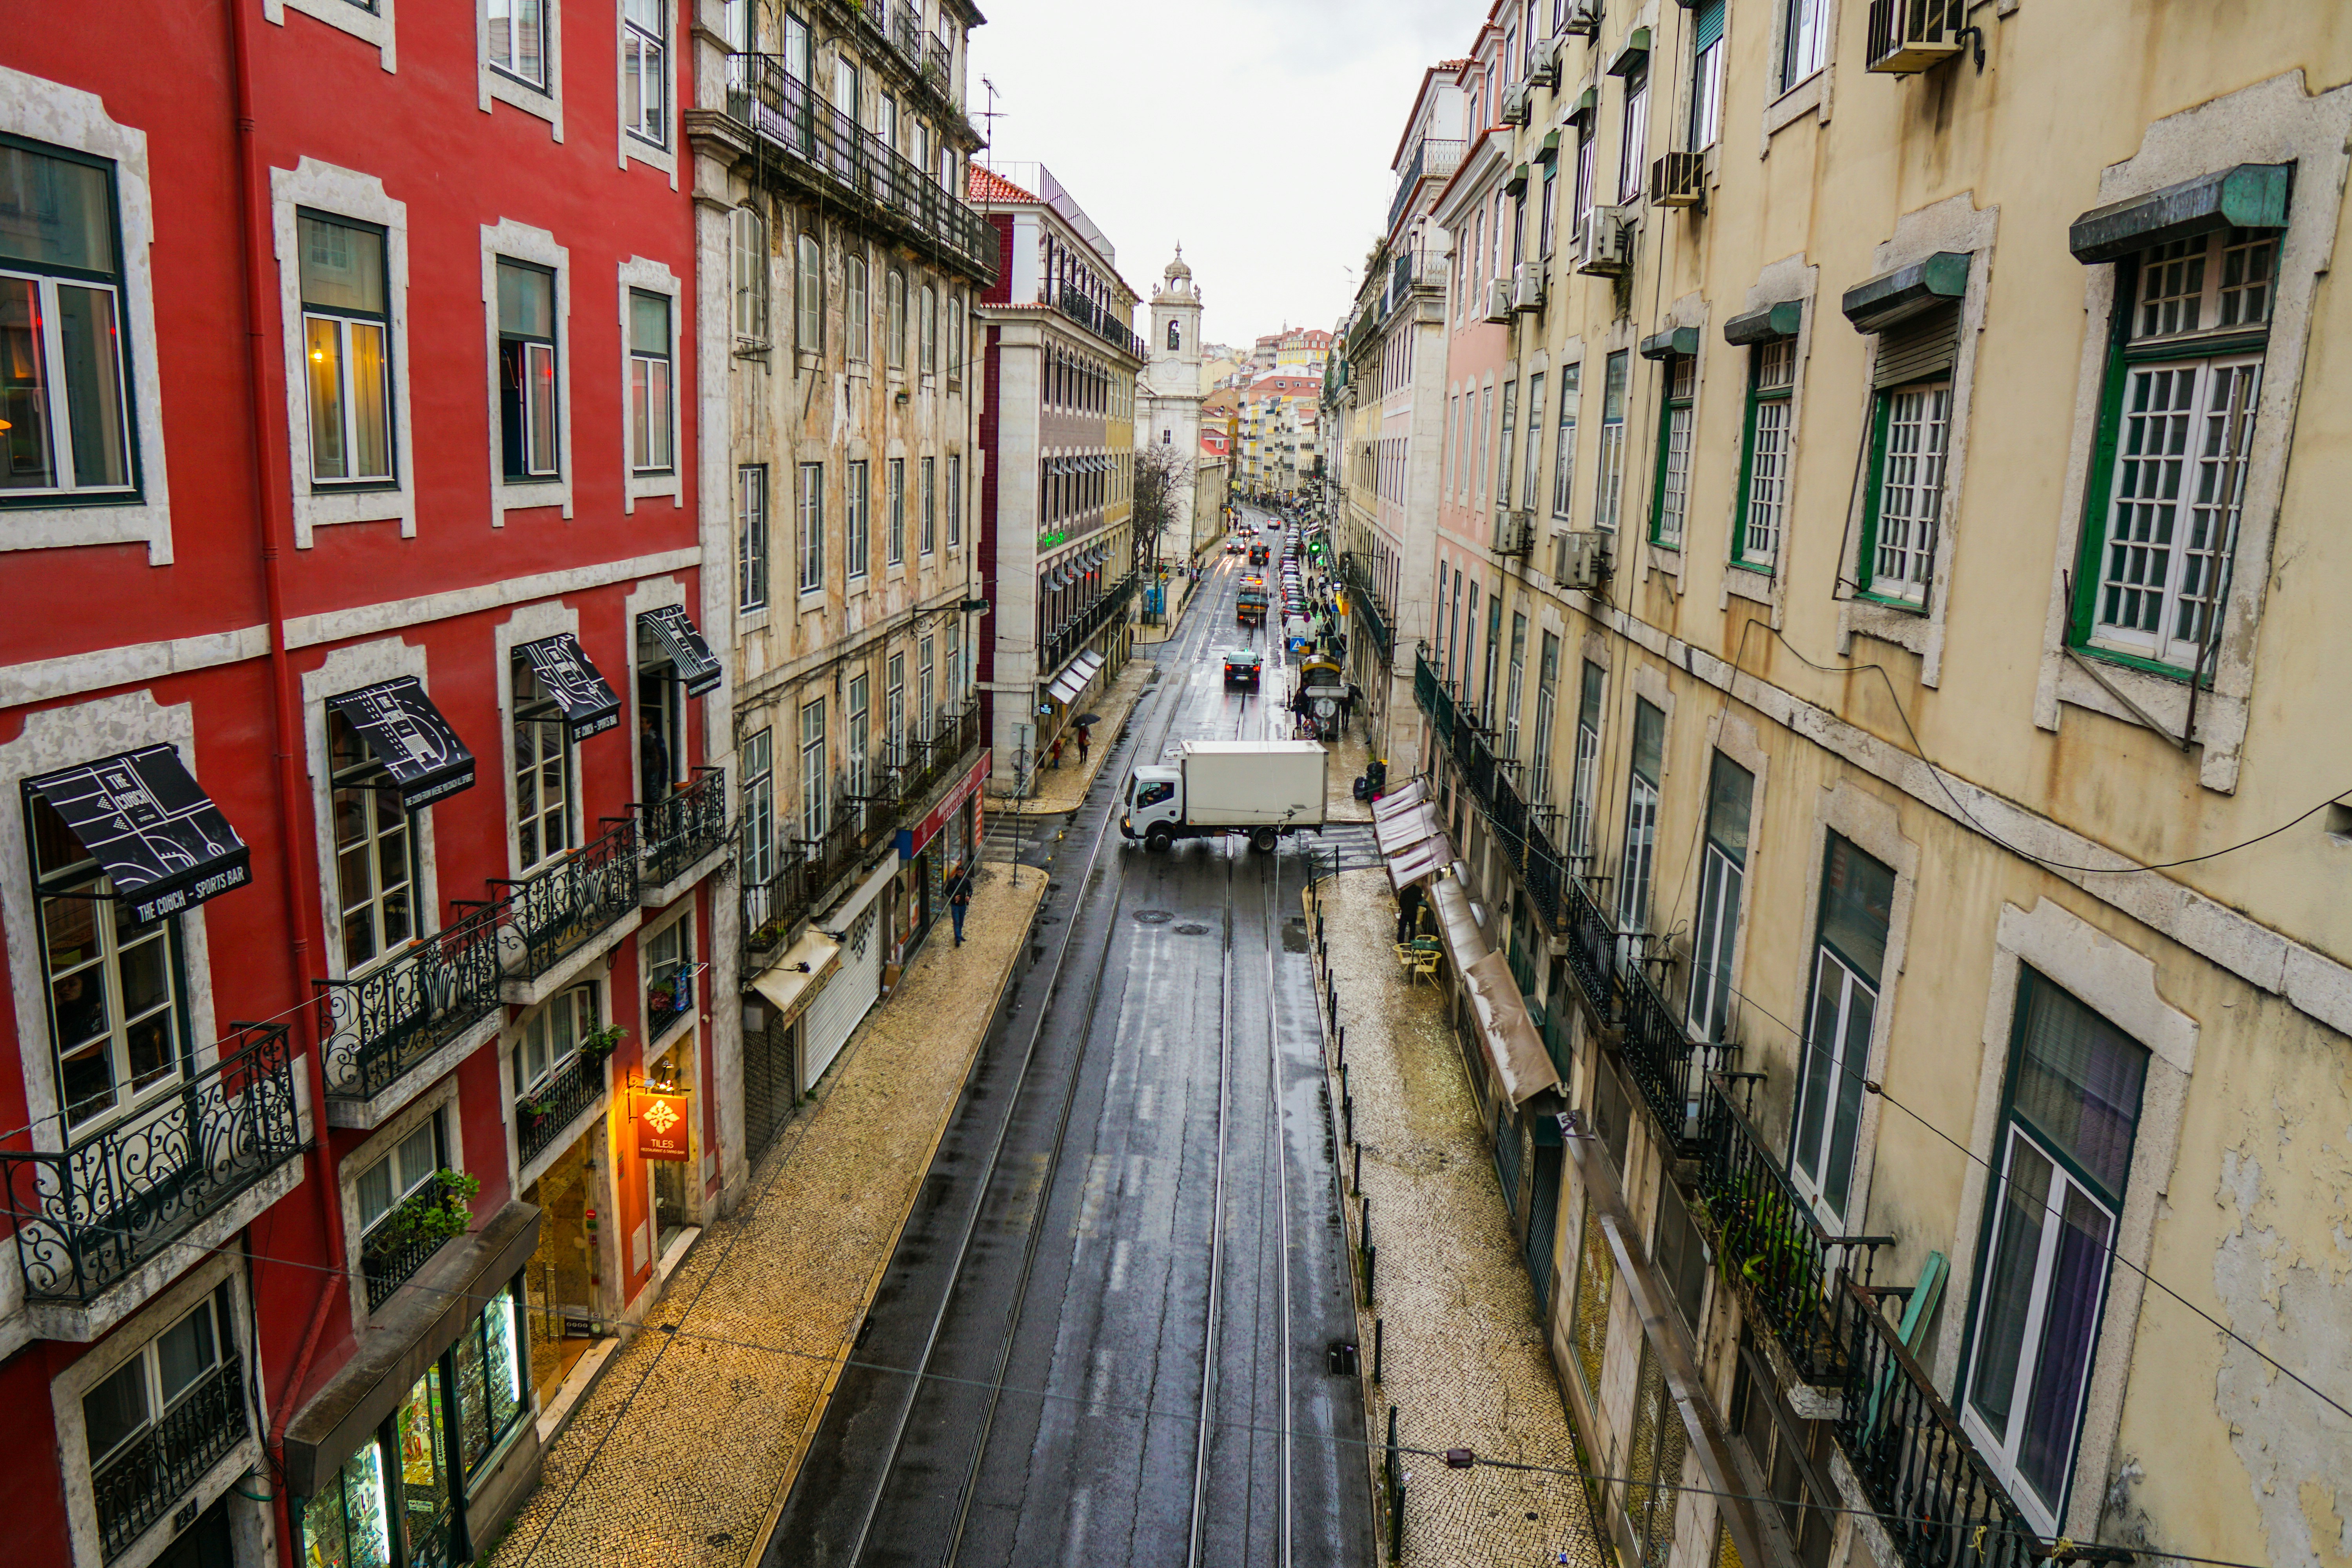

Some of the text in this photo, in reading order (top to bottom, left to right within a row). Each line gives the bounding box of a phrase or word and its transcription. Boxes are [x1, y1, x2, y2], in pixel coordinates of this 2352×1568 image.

[549, 651, 562, 661] THE
[376, 696, 394, 709] THE
[105, 773, 131, 790] THE
[114, 789, 150, 810] COUCH
[137, 902, 156, 923] THE
[156, 889, 186, 915] COUCH
[195, 873, 226, 898] SPORTS
[226, 866, 245, 886] BAR
[651, 1139, 674, 1149] TILES
[180, 1504, 193, 1528] 29
